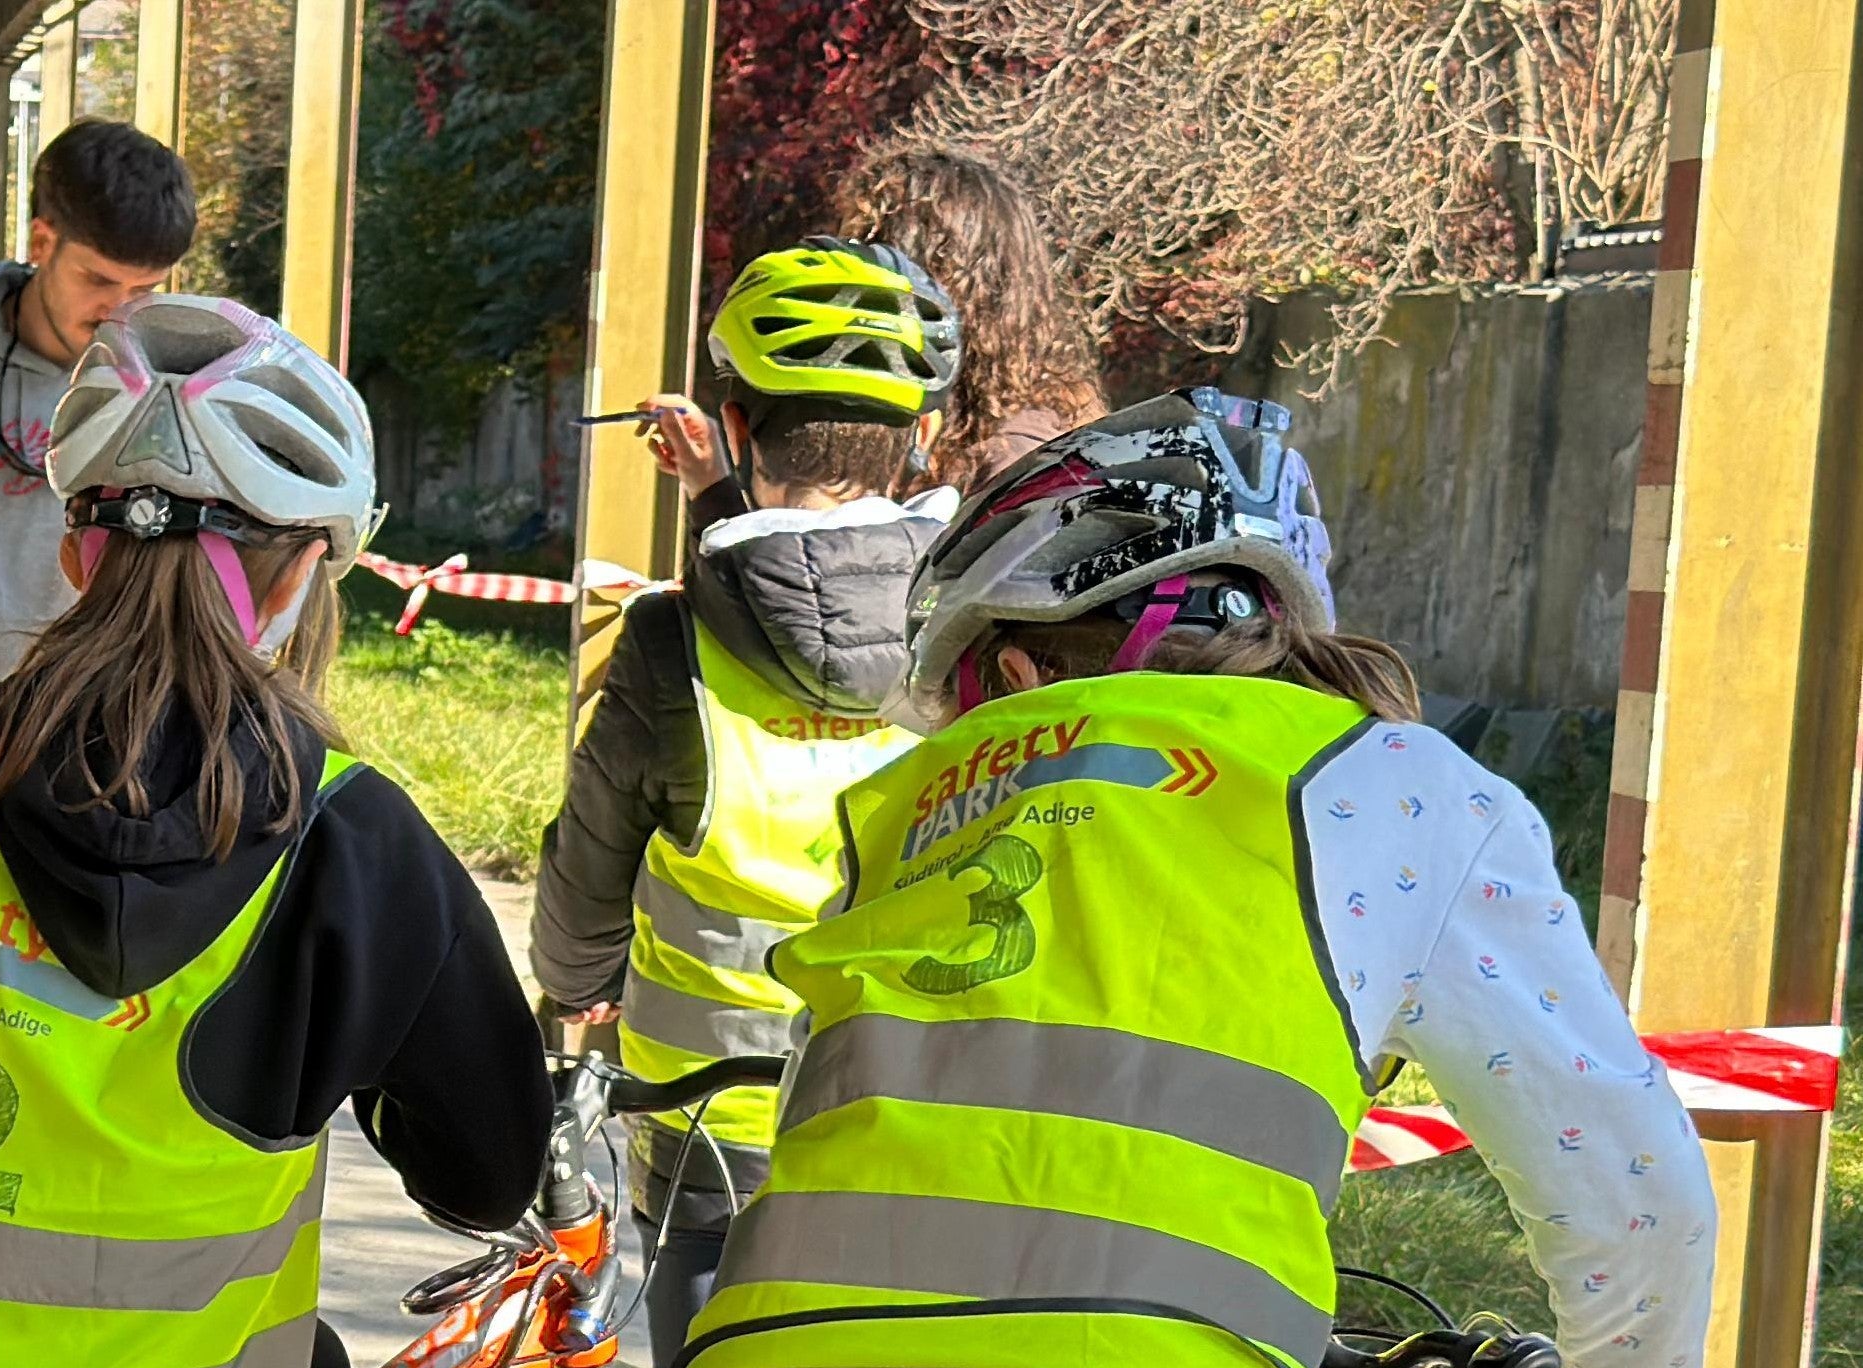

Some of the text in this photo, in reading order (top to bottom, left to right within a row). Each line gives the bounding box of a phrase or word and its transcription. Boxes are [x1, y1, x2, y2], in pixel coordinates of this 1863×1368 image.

[912, 762, 1028, 856] PARK
[914, 713, 1092, 825] safety
[1021, 801, 1096, 826] Adige
[900, 834, 1044, 996] 3
